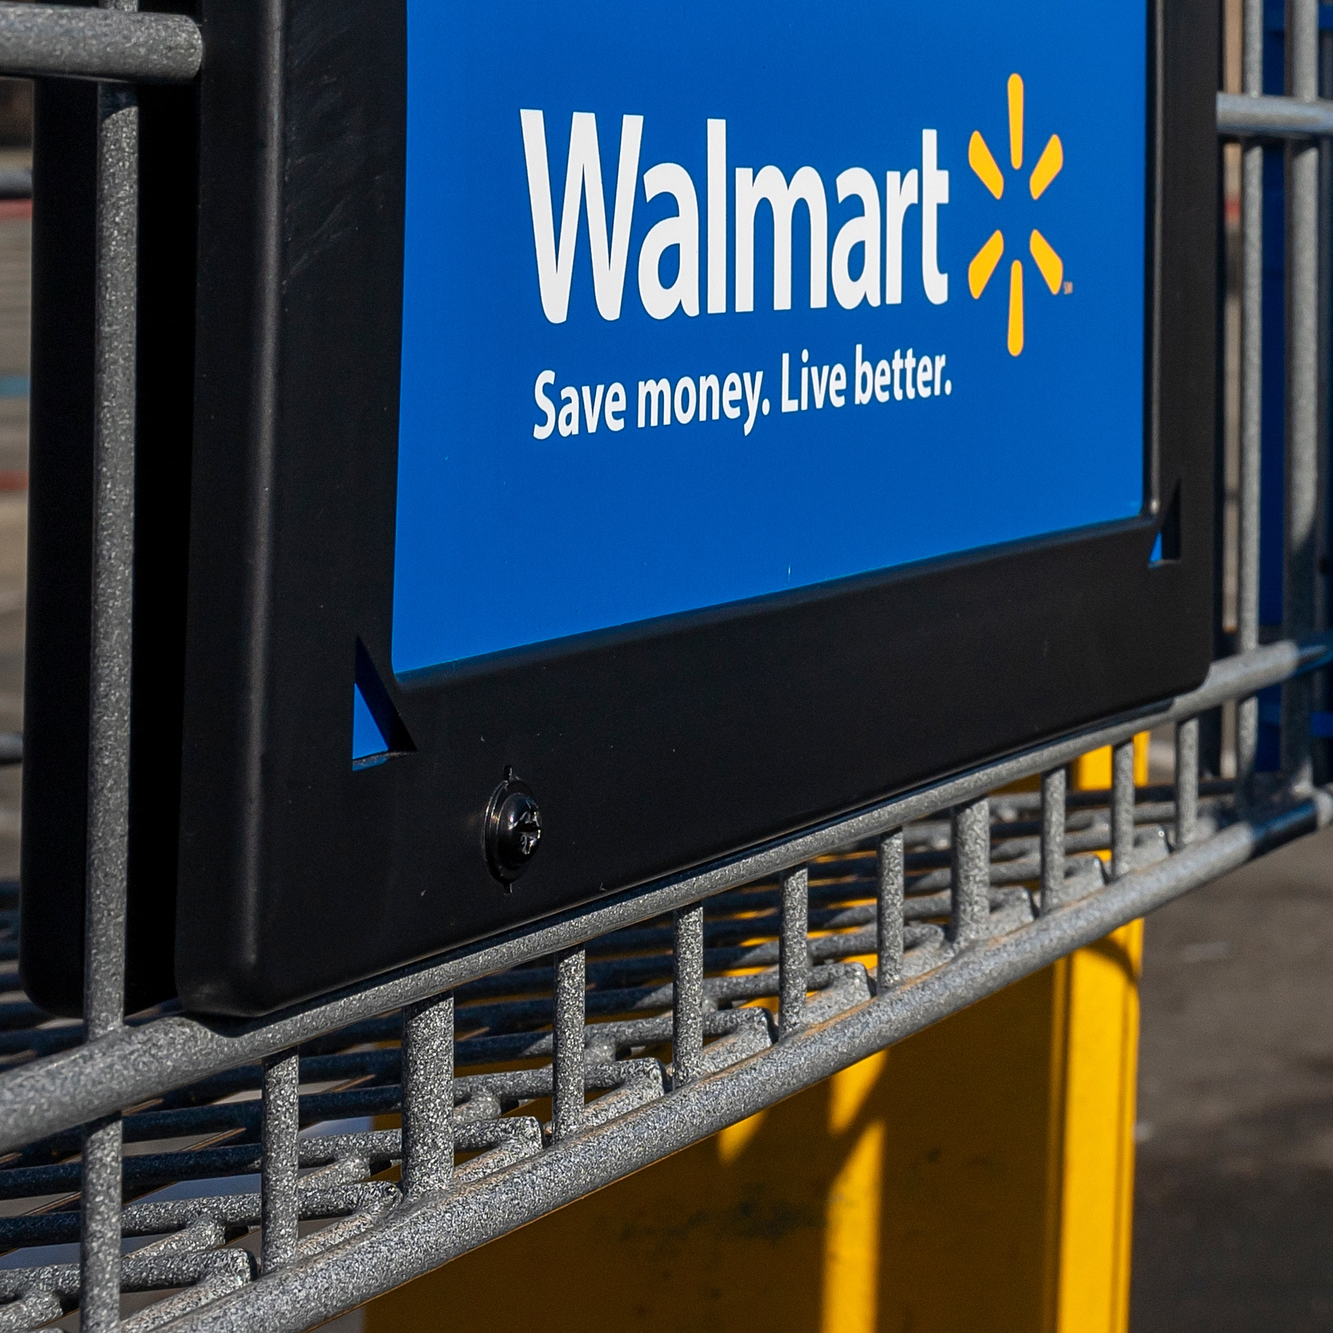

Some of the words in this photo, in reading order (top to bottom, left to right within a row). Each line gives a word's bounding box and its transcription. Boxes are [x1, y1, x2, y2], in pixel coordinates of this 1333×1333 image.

[519, 108, 950, 324] Walmart
[533, 369, 627, 440] Save
[637, 369, 771, 436] money.
[781, 348, 847, 413] Live
[854, 343, 952, 405] better.
